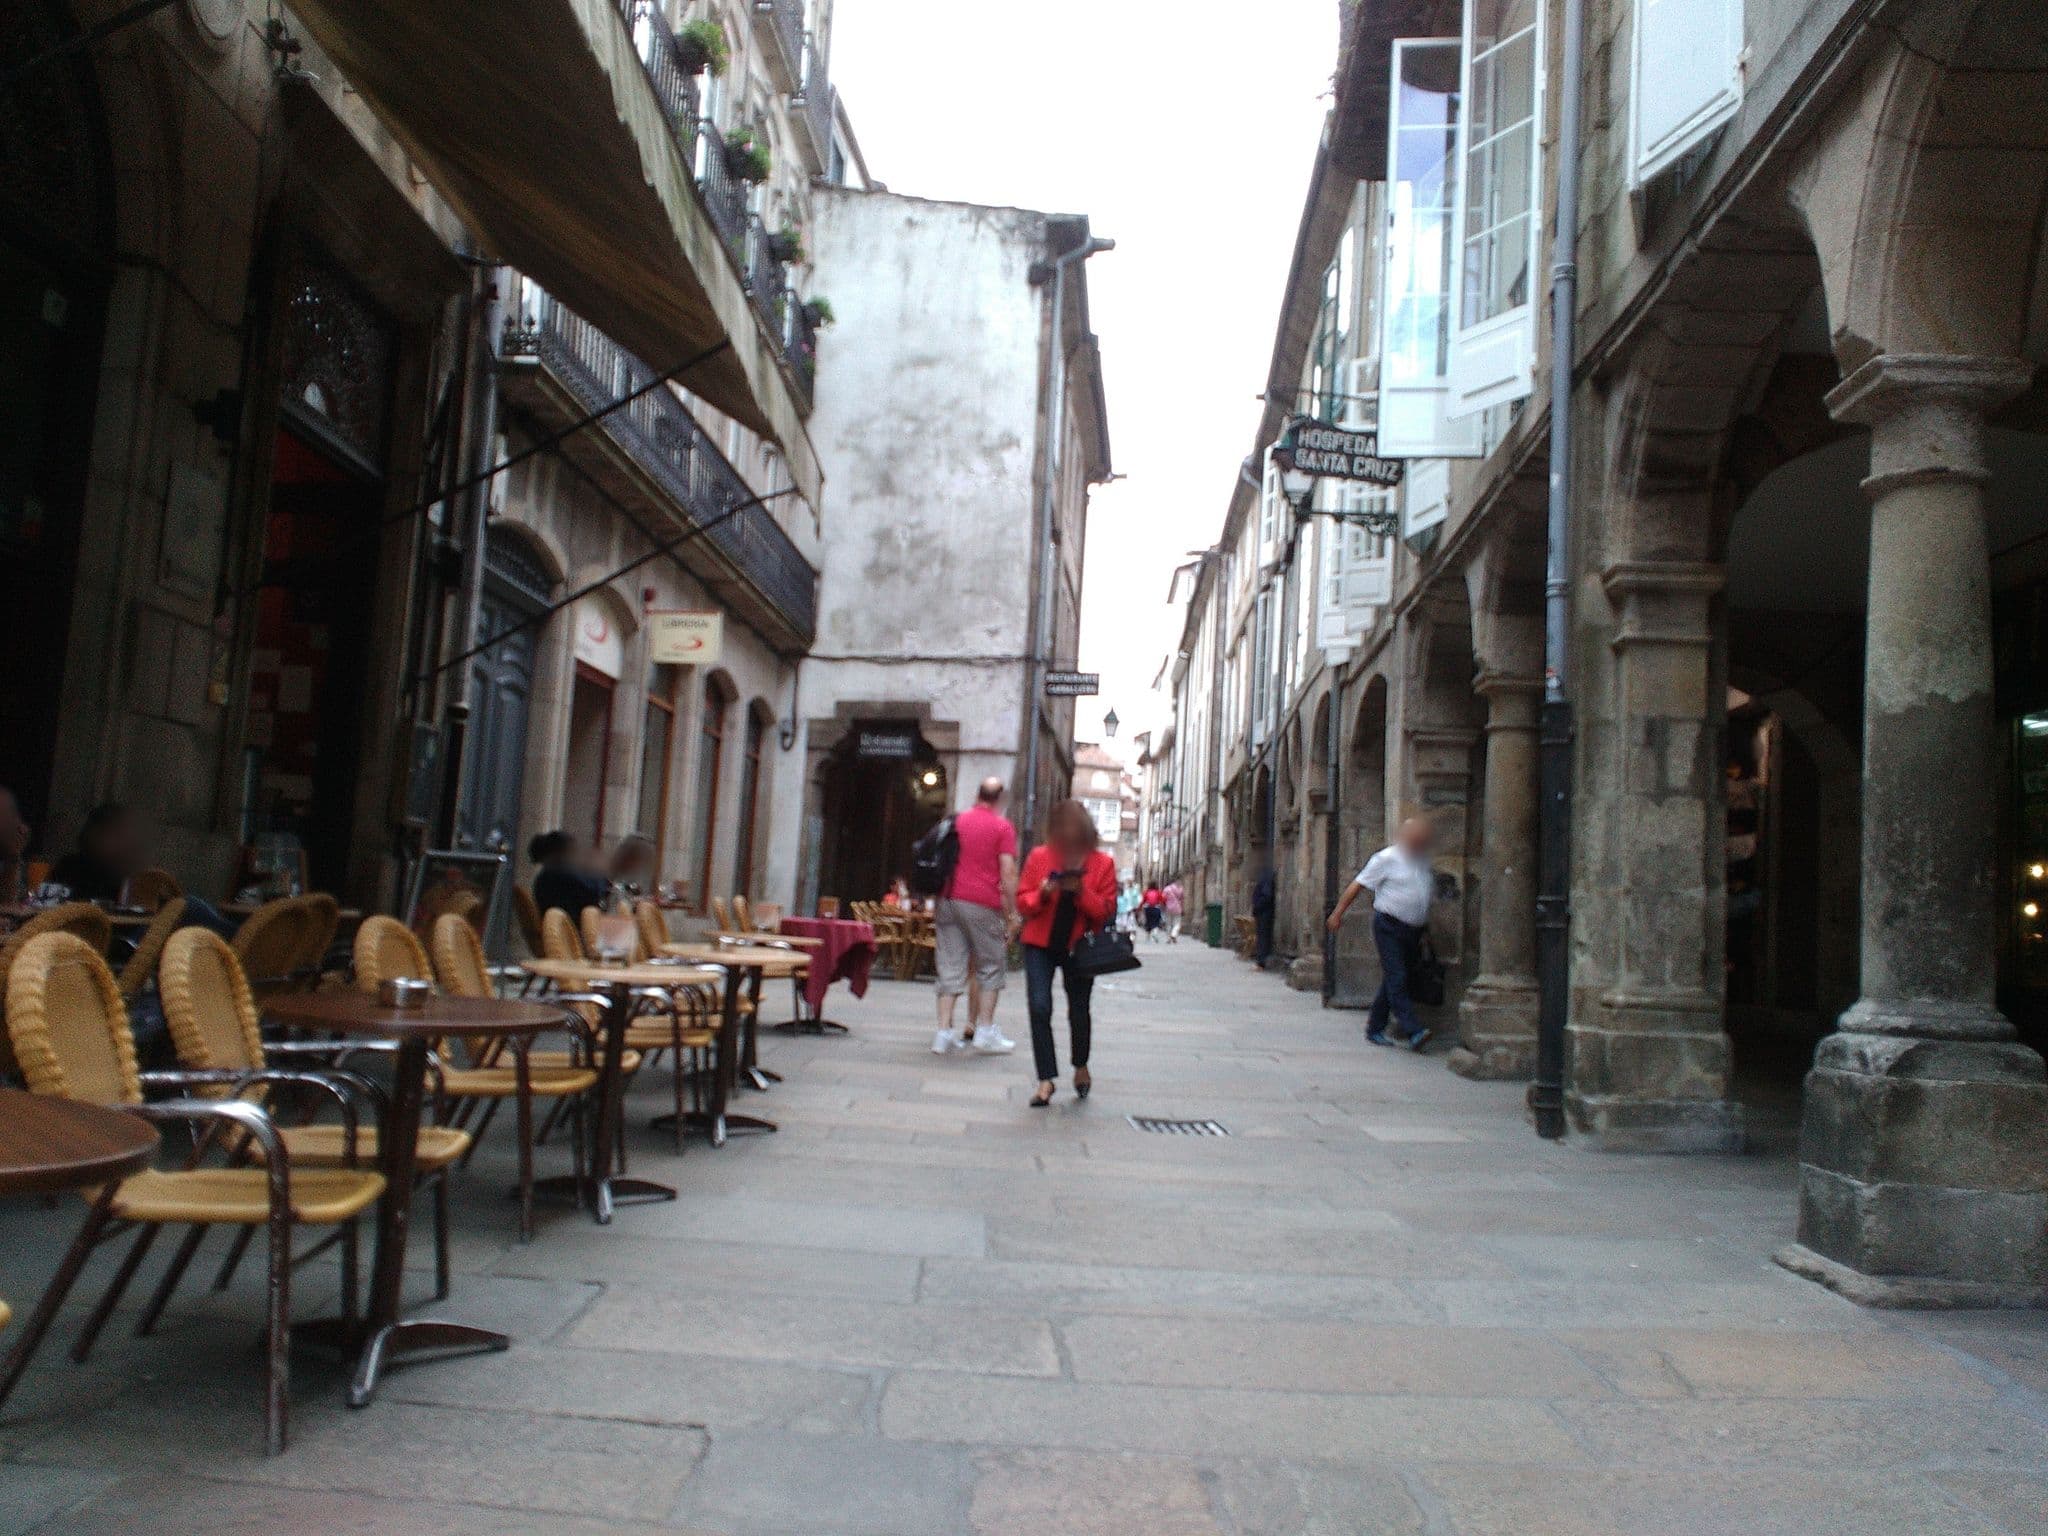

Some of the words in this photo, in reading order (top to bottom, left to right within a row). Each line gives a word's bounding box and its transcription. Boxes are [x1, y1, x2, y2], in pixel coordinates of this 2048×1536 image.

[1297, 428, 1376, 457] HOSPEDA
[1295, 447, 1350, 475] SANTA
[1352, 456, 1400, 481] CRUZ
